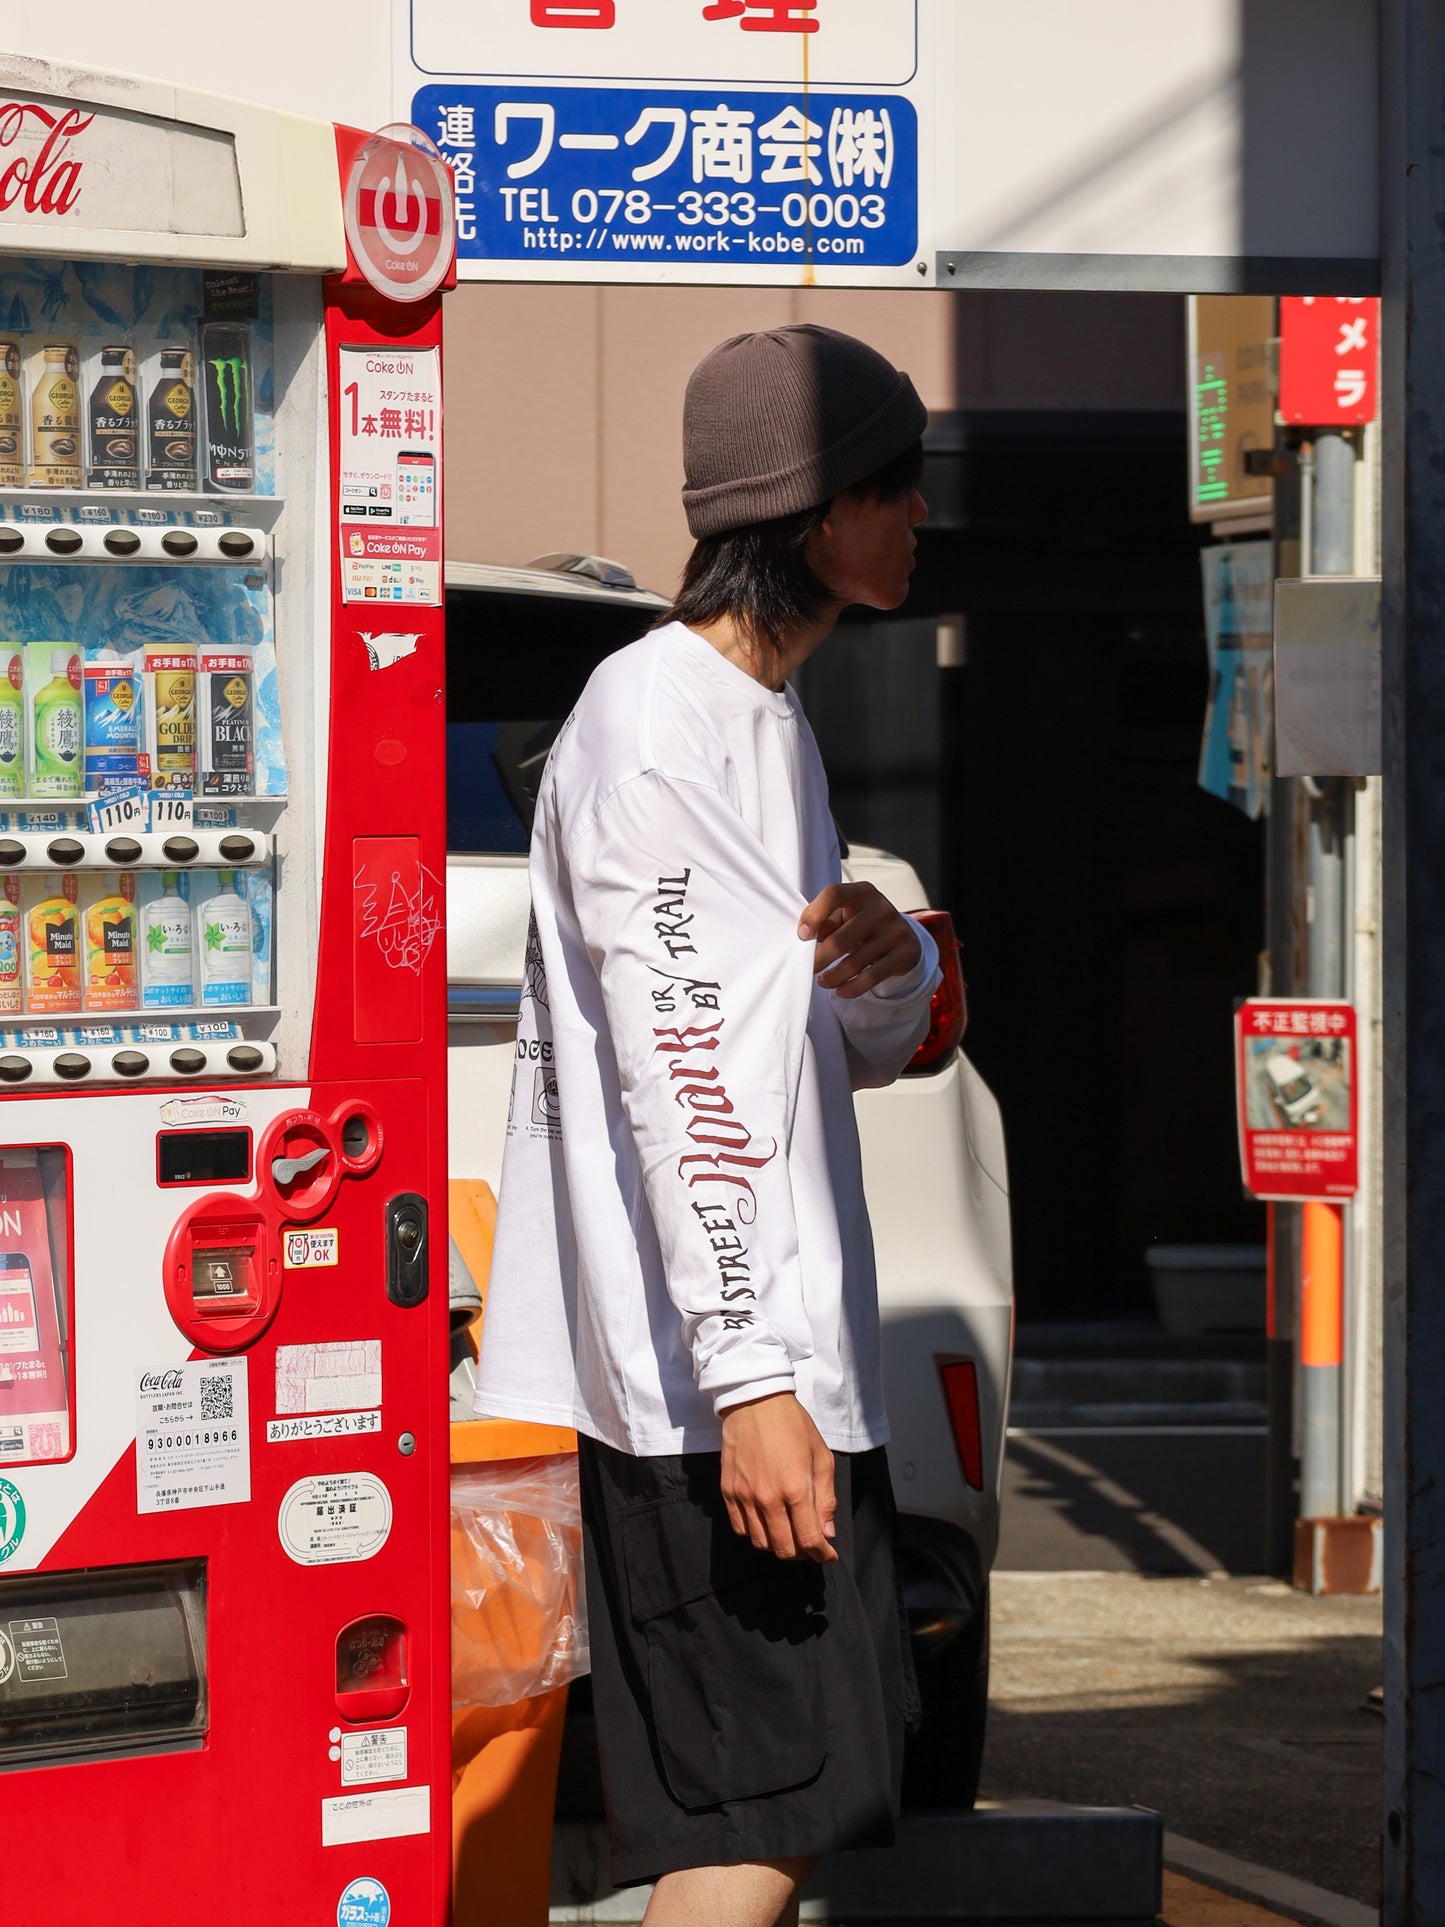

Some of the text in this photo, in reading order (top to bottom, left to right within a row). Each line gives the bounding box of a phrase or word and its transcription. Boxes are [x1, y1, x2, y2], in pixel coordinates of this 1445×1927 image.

[0, 103, 96, 216] ola
[499, 187, 559, 223] TEL
[385, 259, 404, 271] Coke
[366, 360, 394, 374] Coke
[379, 390, 434, 402] スタンプたまると
[209, 442, 252, 460] MONST
[367, 542, 391, 554] Coke
[408, 544, 427, 558] Pay
[57, 708, 75, 750] 綾鷹
[159, 722, 196, 736] GOLDE
[157, 801, 191, 821] 110円
[653, 867, 699, 961] TRAIL
[50, 932, 74, 941] Minute
[107, 931, 131, 940] Minute
[54, 941, 72, 949] Maid
[111, 939, 129, 948] Maid
[1253, 1010, 1347, 1034] 不正監視中
[222, 1105, 241, 1118] Pay
[311, 1239, 334, 1248] 使えます
[690, 1200, 758, 1301] STREET
[314, 1249, 330, 1261] OK
[216, 1283, 230, 1291] 1000
[140, 1369, 184, 1392] Coca-Cola
[159, 1415, 185, 1424] こちらから
[269, 1413, 379, 1440] ありがとうございます
[148, 1429, 237, 1450] 9300018966
[371, 1734, 388, 1746] 警告
[332, 1800, 373, 1812] ここの住所は
